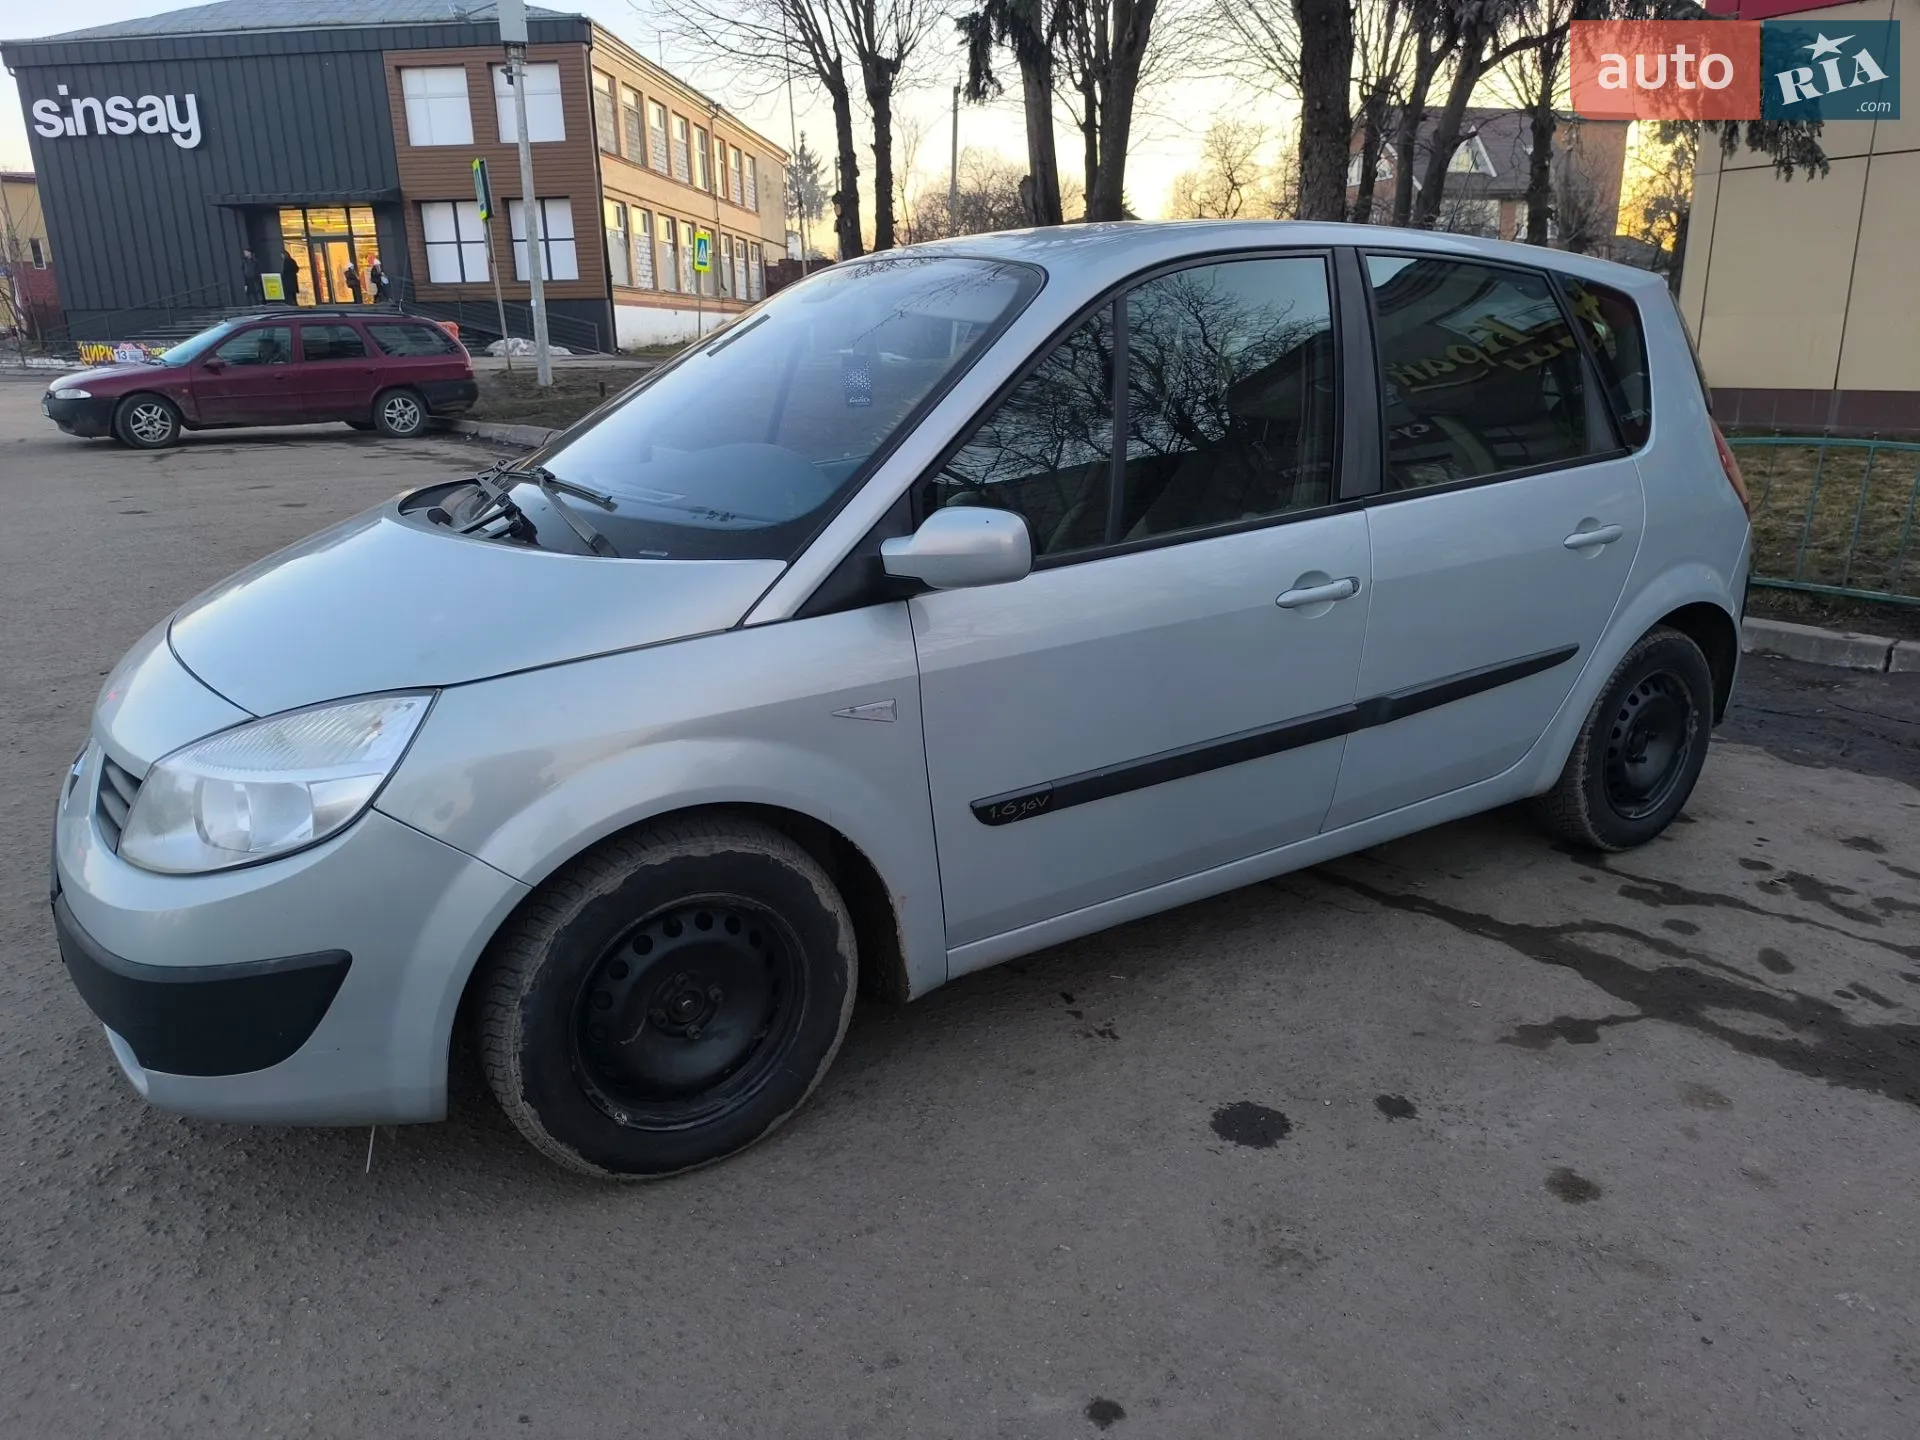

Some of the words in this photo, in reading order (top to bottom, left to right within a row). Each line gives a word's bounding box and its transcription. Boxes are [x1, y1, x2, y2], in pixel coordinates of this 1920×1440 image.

[32, 84, 202, 149] sinsay
[81, 344, 116, 364] ЦИРК
[116, 350, 127, 360] 13
[989, 801, 1016, 818] 1.6
